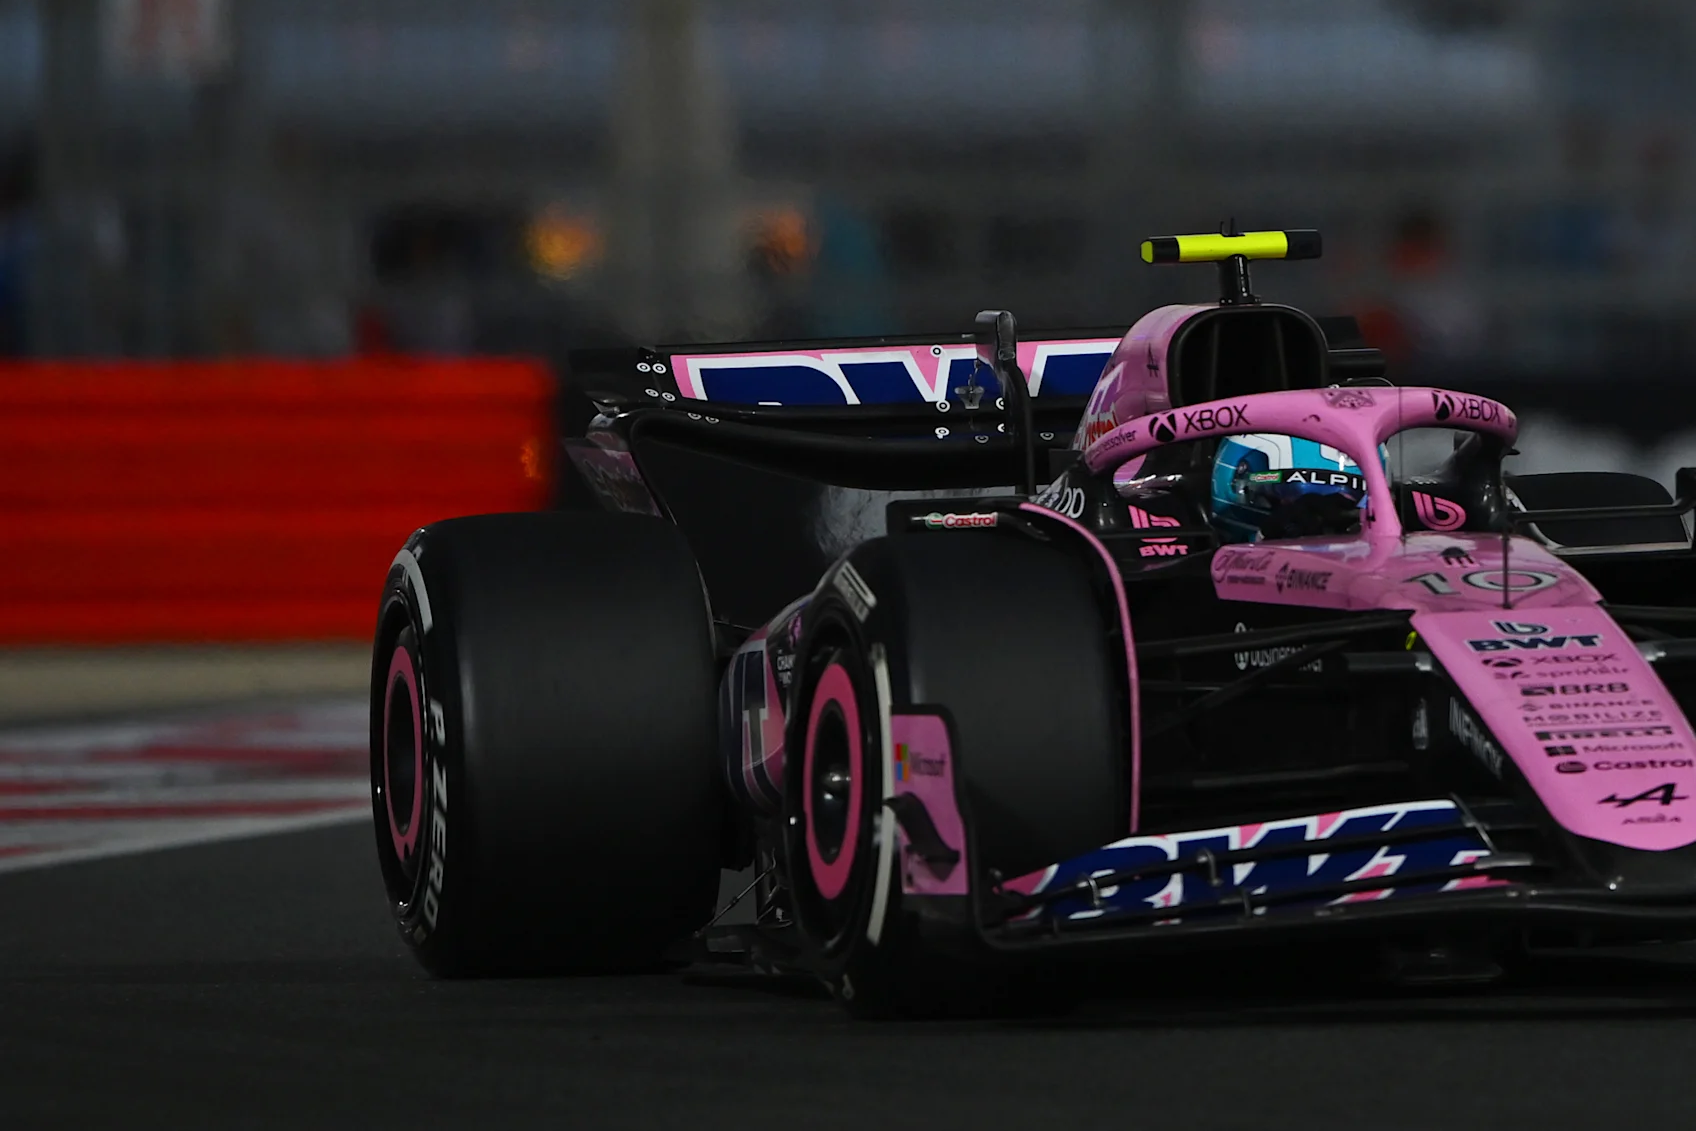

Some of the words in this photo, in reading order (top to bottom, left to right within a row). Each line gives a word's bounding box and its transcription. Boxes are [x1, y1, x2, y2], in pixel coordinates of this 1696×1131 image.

[1183, 404, 1250, 433] XBOX
[1456, 396, 1501, 424] XBOX
[943, 511, 998, 529] Castrol
[1138, 544, 1189, 557] BWT
[1401, 570, 1557, 596] 10
[1464, 634, 1602, 653] BWT
[1529, 653, 1621, 664] XBOX
[1559, 682, 1630, 695] BRB
[1593, 759, 1695, 770] Castrol
[424, 756, 448, 933] ZERO
